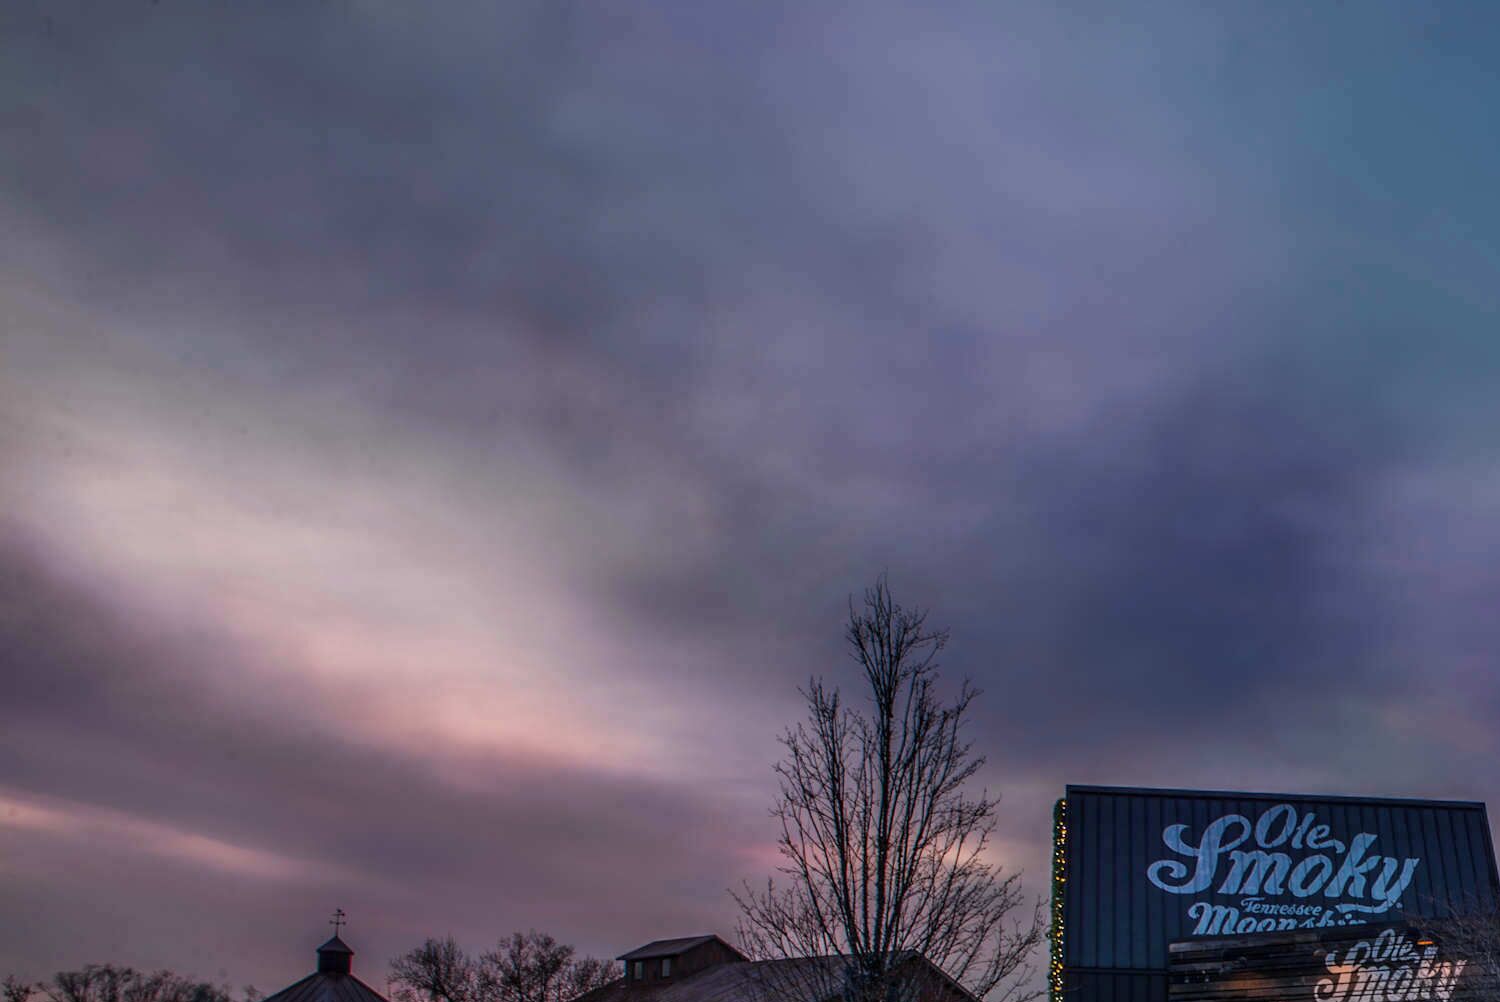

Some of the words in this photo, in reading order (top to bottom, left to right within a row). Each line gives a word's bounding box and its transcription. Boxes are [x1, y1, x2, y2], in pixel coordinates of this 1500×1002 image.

[1255, 803, 1346, 853] Ole
[1147, 814, 1420, 914] Smoky
[1240, 897, 1322, 916] Tennessee
[1370, 928, 1421, 964] Ole
